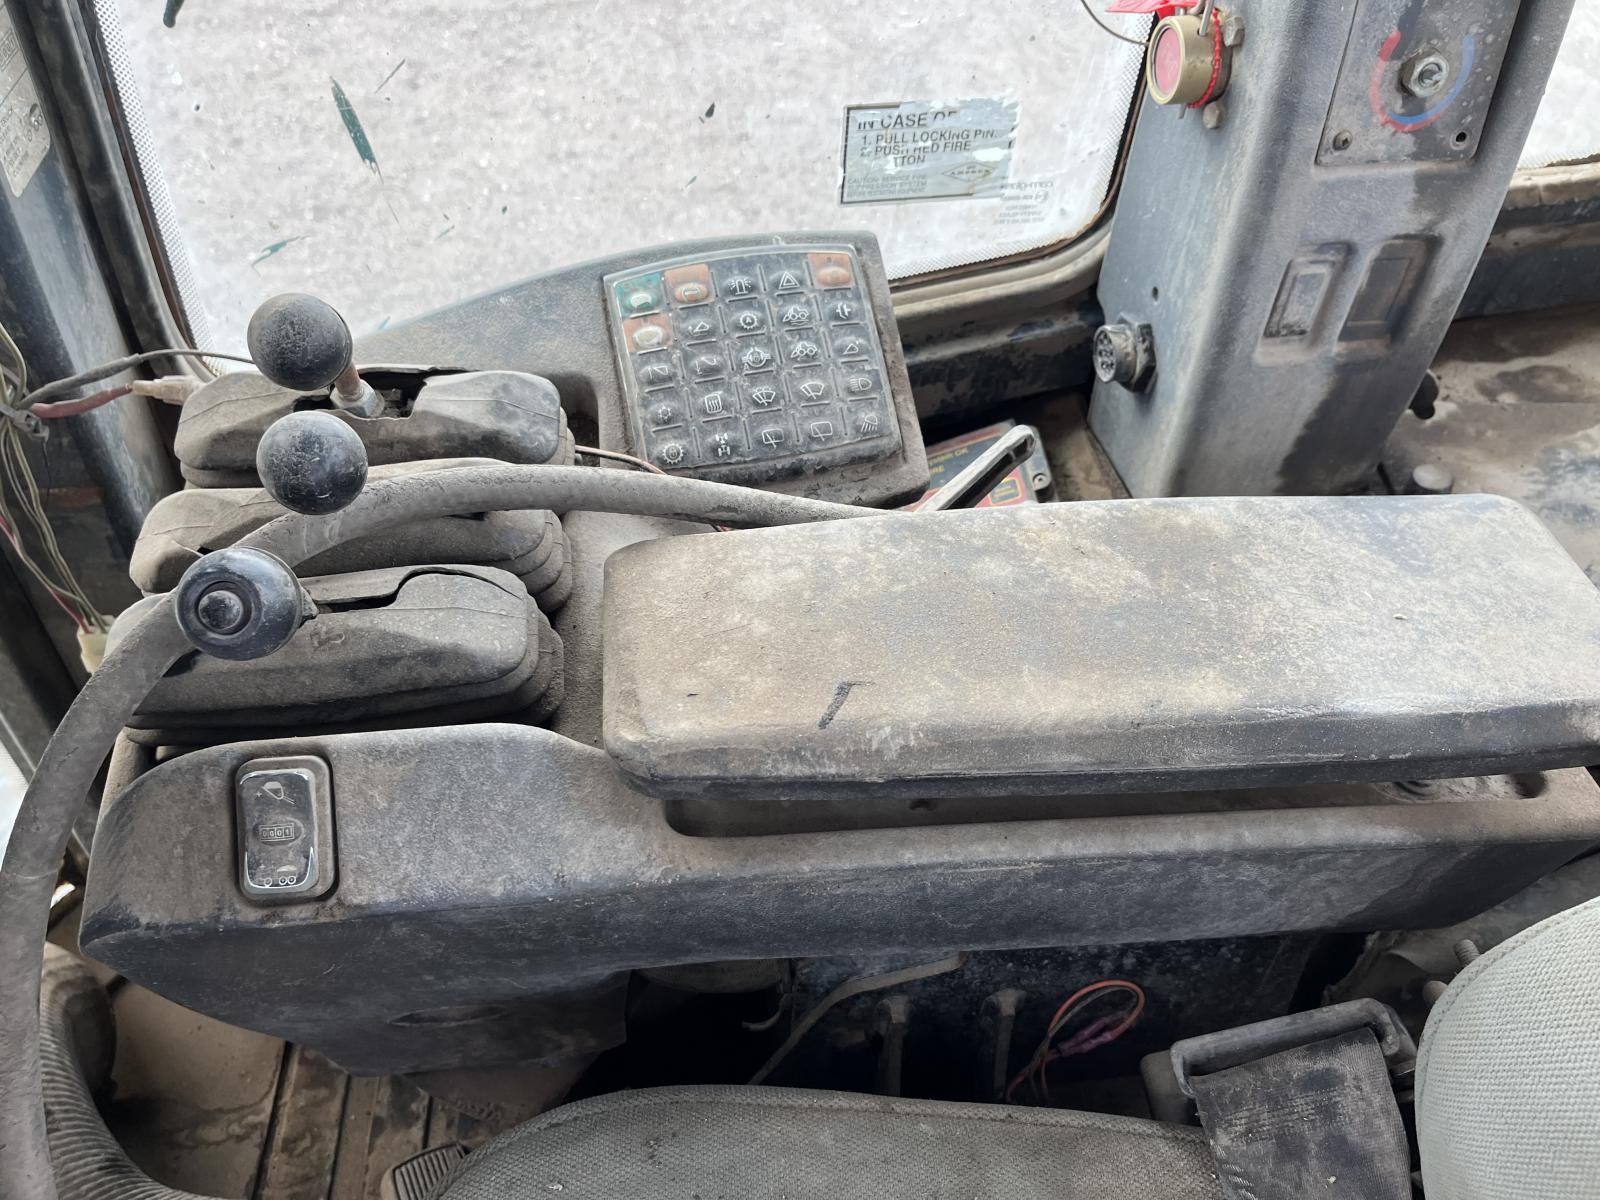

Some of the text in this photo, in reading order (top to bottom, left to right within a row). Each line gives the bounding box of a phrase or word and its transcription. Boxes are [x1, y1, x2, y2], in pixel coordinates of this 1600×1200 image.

[880, 112, 929, 129] CASE
[861, 134, 872, 146] 1.
[875, 131, 909, 145] PULL
[912, 129, 971, 144] LOCKING
[942, 140, 972, 153] FIRE
